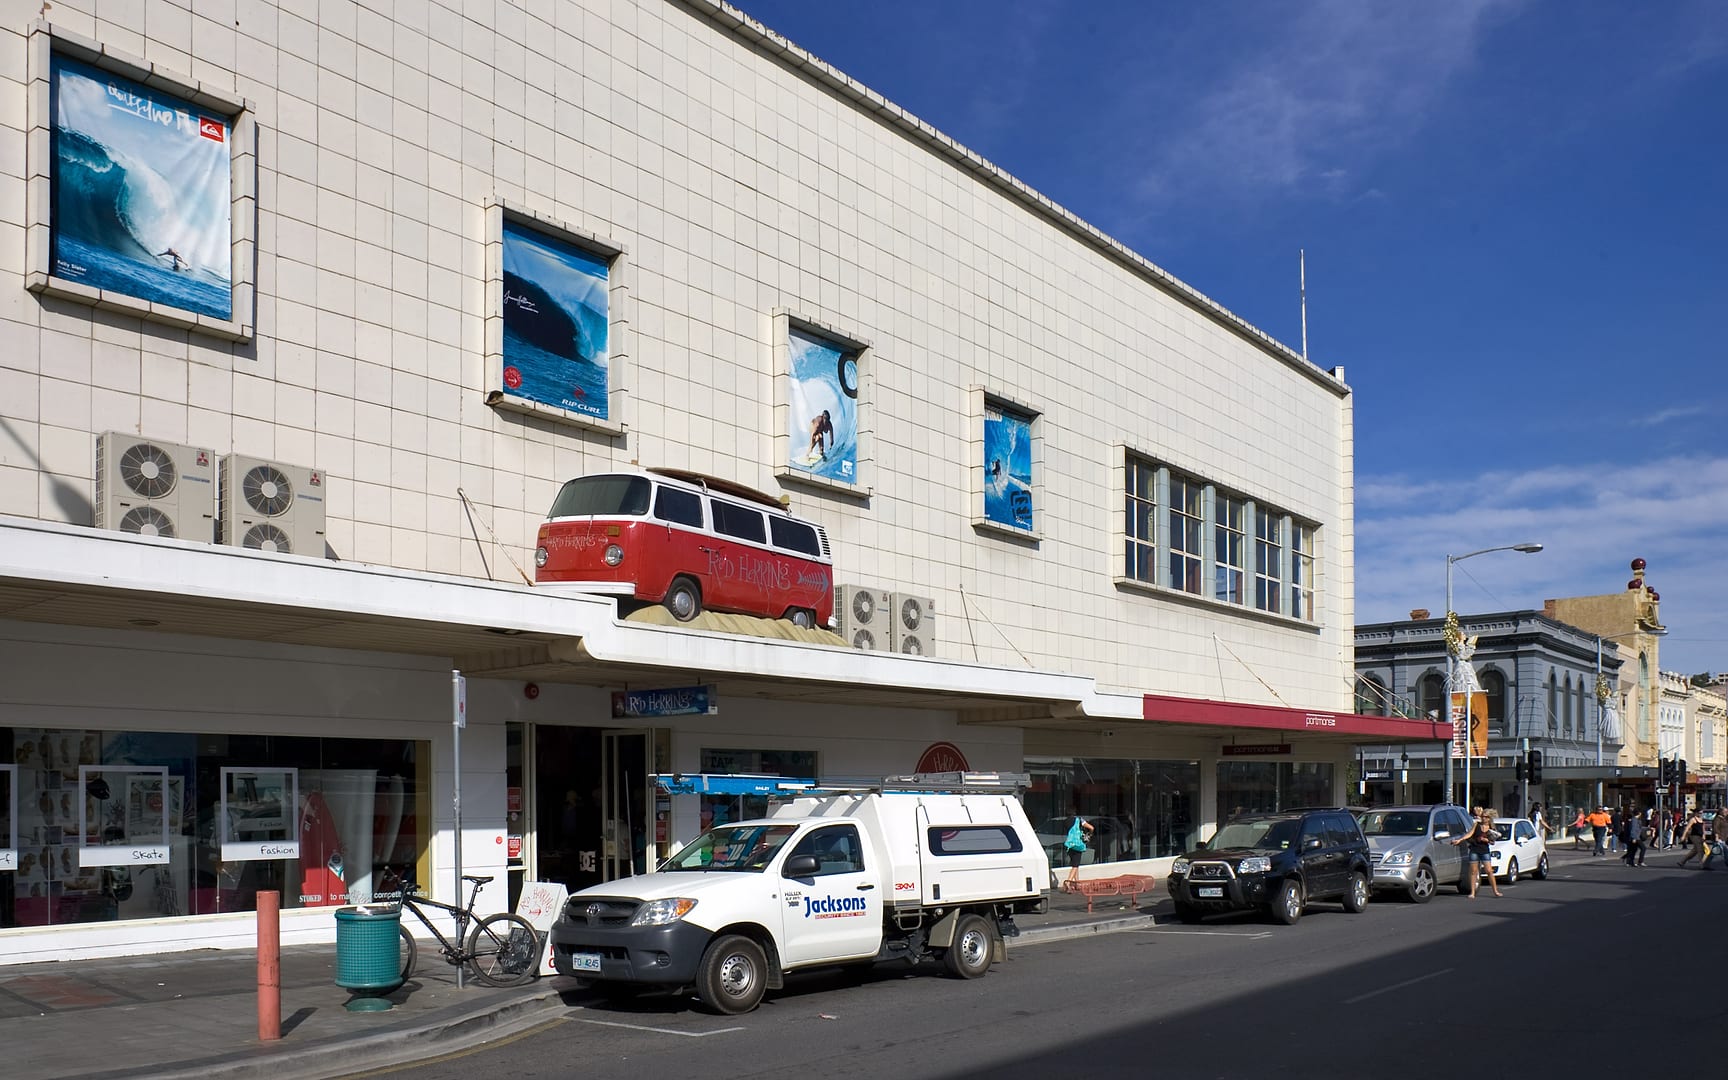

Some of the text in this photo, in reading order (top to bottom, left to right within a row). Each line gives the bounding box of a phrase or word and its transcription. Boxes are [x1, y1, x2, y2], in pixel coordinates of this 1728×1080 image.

[561, 398, 601, 415] RIP CURL
[1451, 705, 1467, 756] FASHION
[132, 849, 164, 860] Skate
[260, 846, 295, 856] Fashion
[330, 892, 338, 901] to
[803, 895, 867, 918] Jacksons
